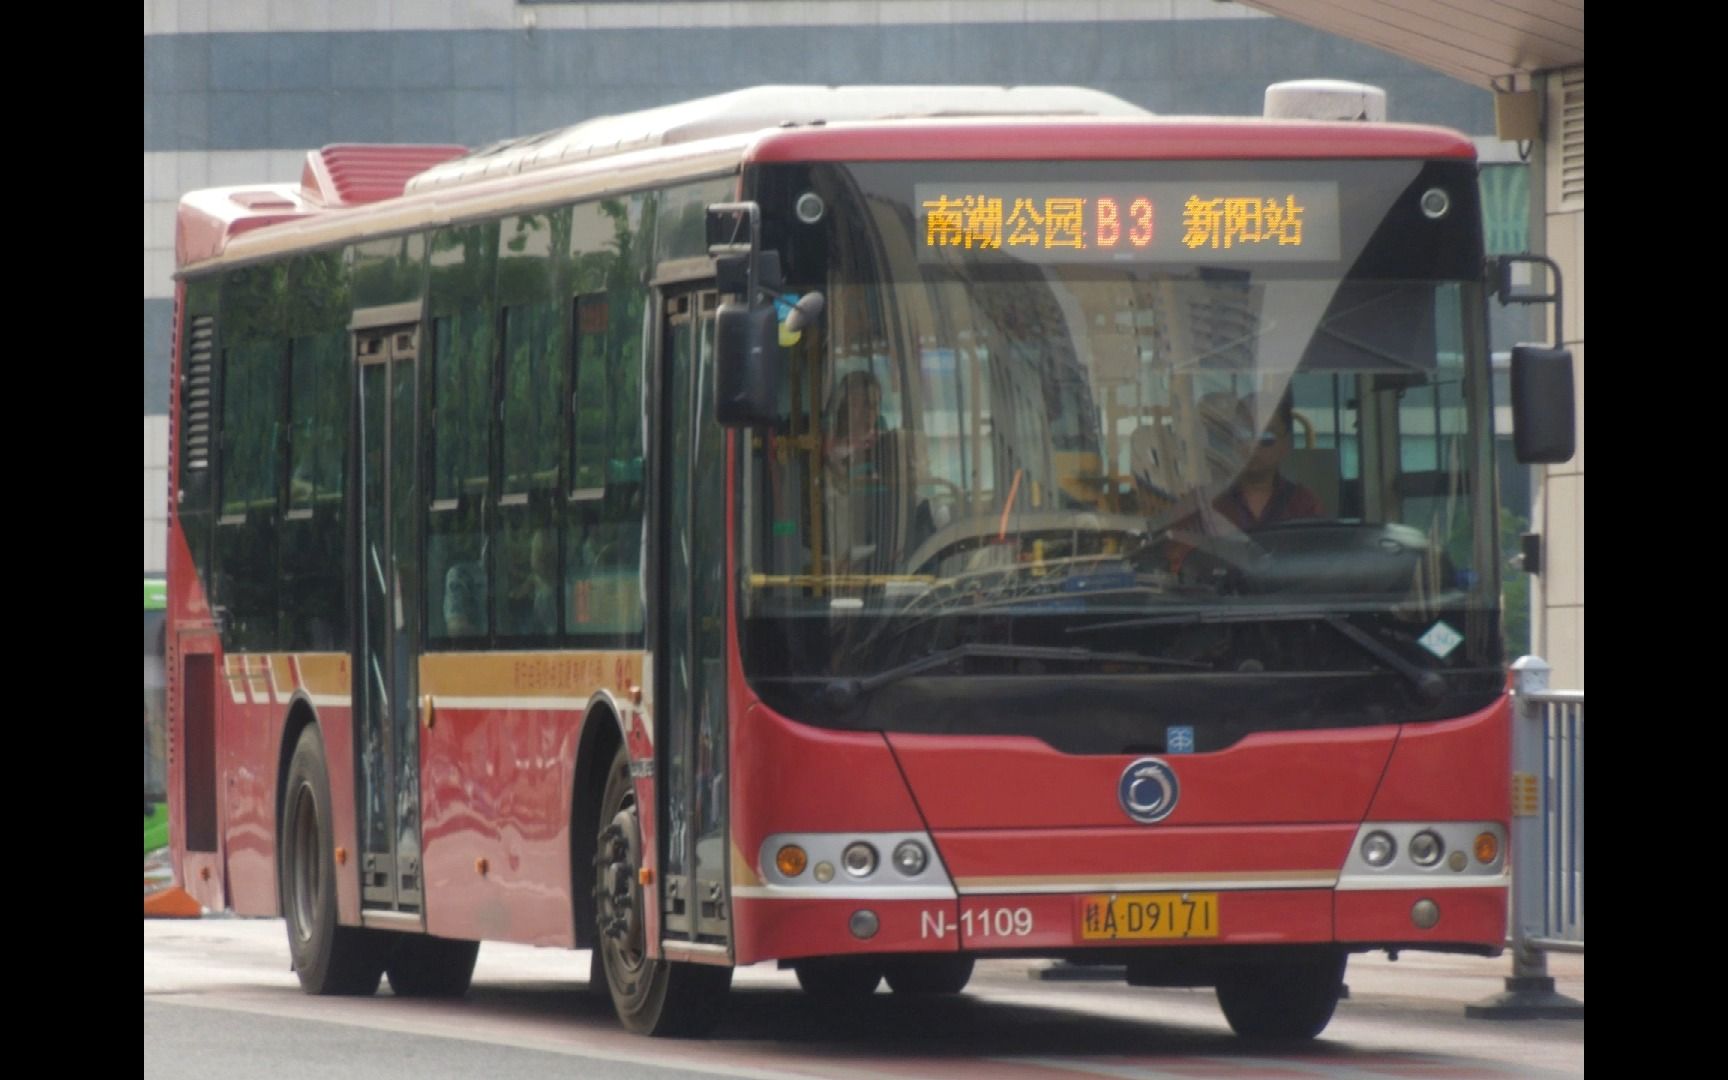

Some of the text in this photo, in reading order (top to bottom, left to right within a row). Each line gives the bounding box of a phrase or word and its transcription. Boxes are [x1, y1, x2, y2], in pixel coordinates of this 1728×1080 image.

[922, 194, 1083, 249] 南湖公园
[1182, 194, 1304, 249] 新阳站
[921, 907, 1033, 938] N-1109
